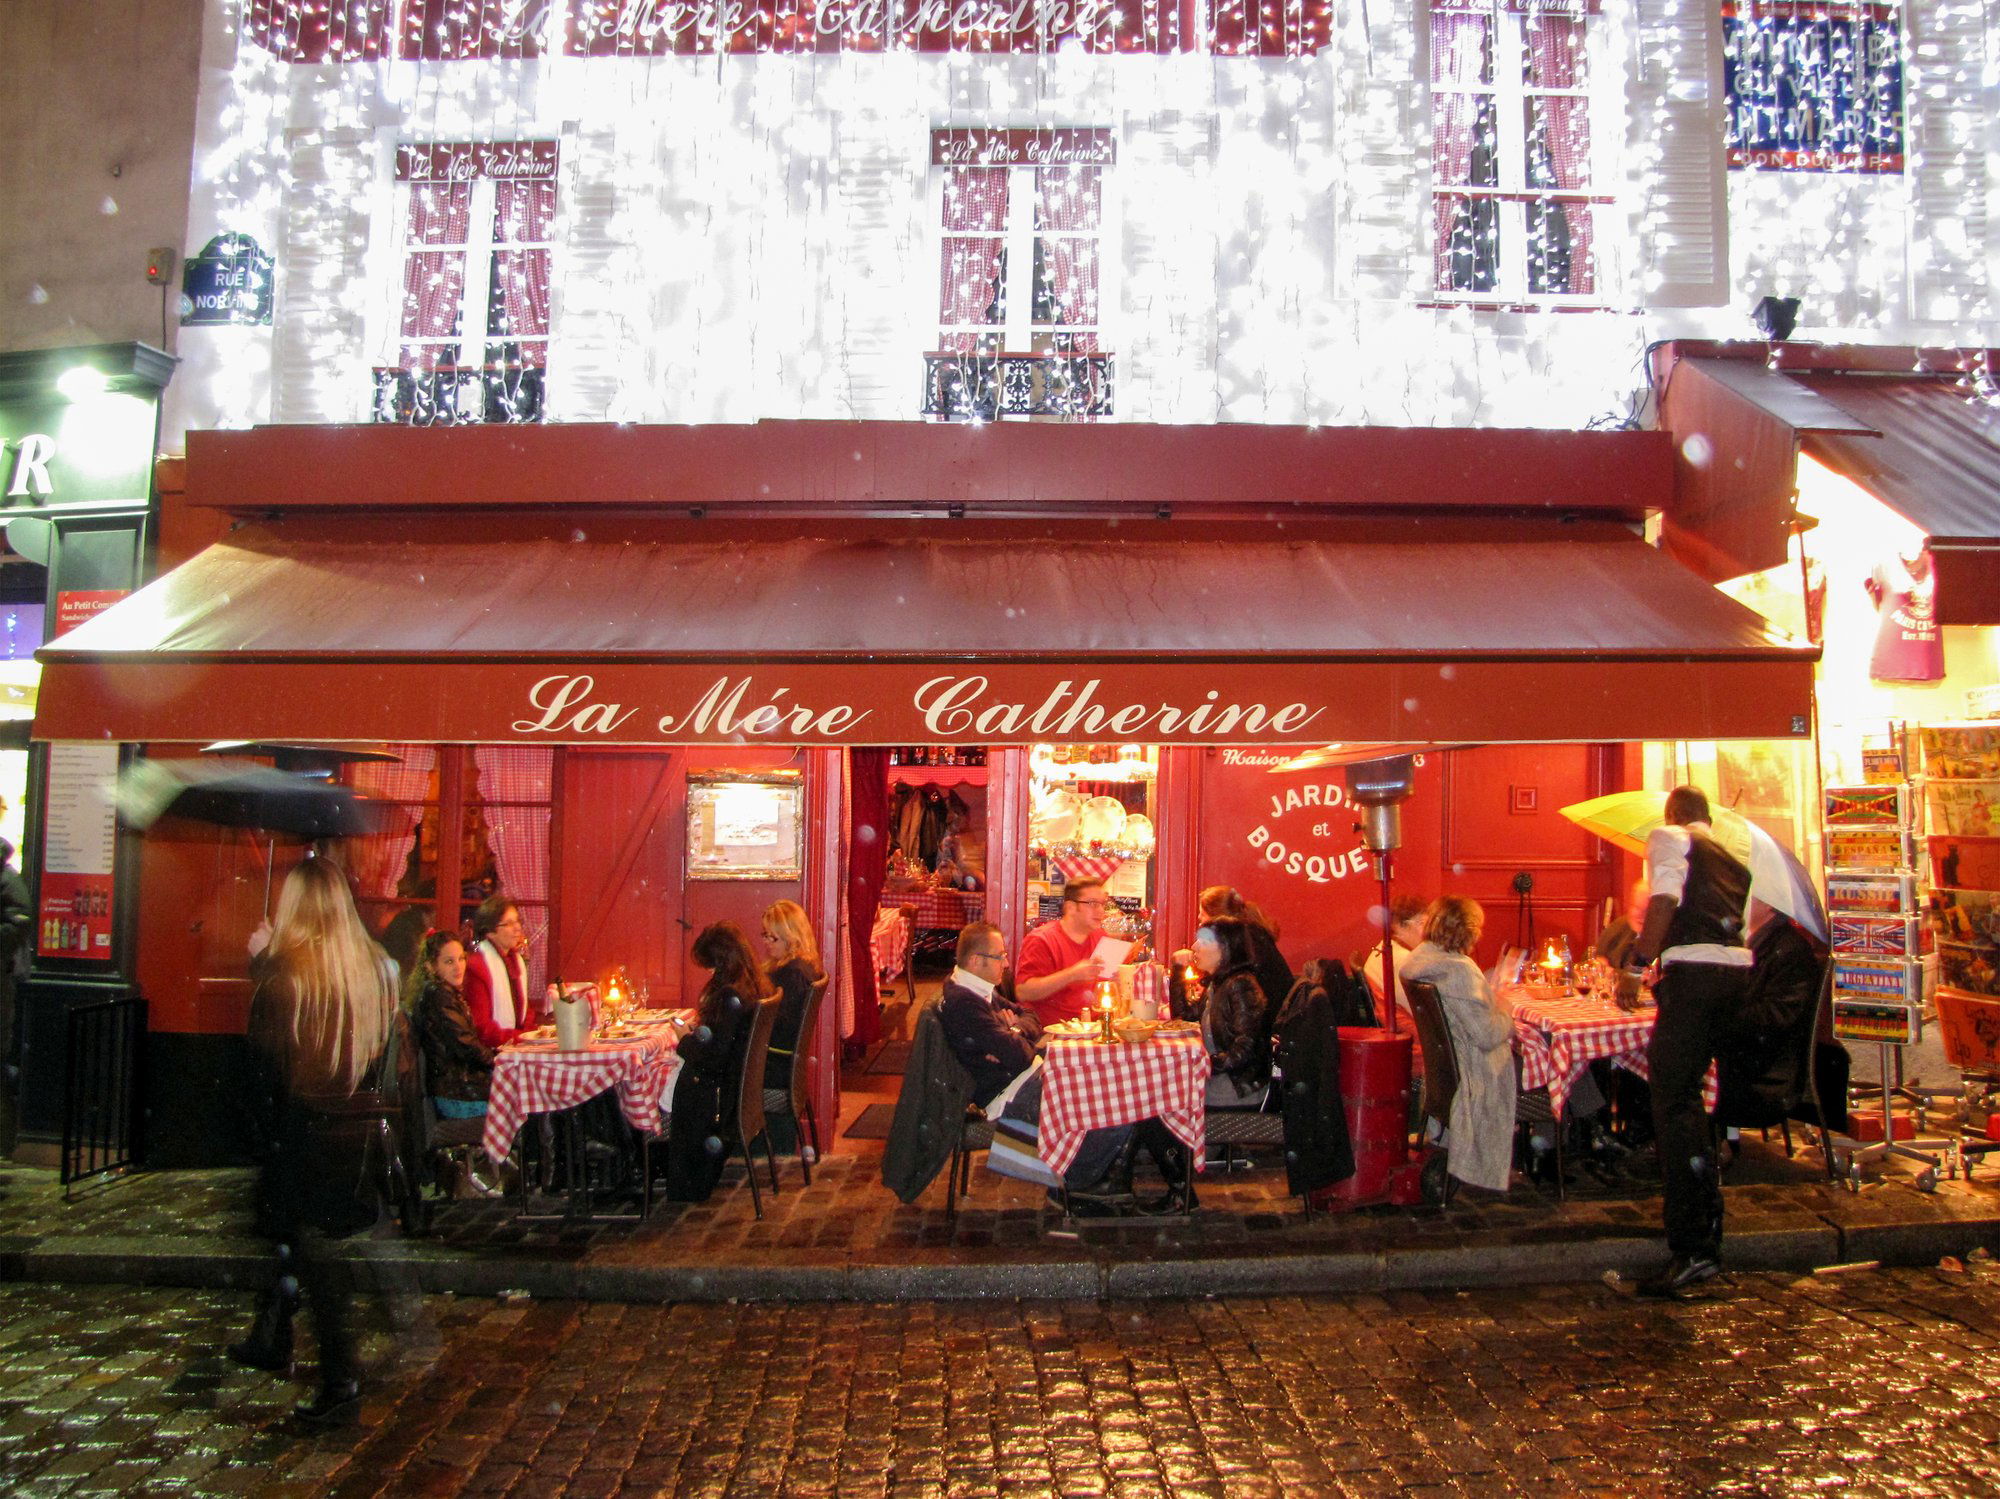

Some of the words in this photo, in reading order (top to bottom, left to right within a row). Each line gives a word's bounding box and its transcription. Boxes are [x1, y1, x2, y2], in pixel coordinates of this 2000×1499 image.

[215, 272, 244, 287] RUE
[511, 675, 640, 734] La
[912, 675, 1328, 735] Catherine
[1222, 748, 1291, 767] Maison
[1312, 821, 1331, 837] et
[1247, 825, 1369, 883] BOSQUE
